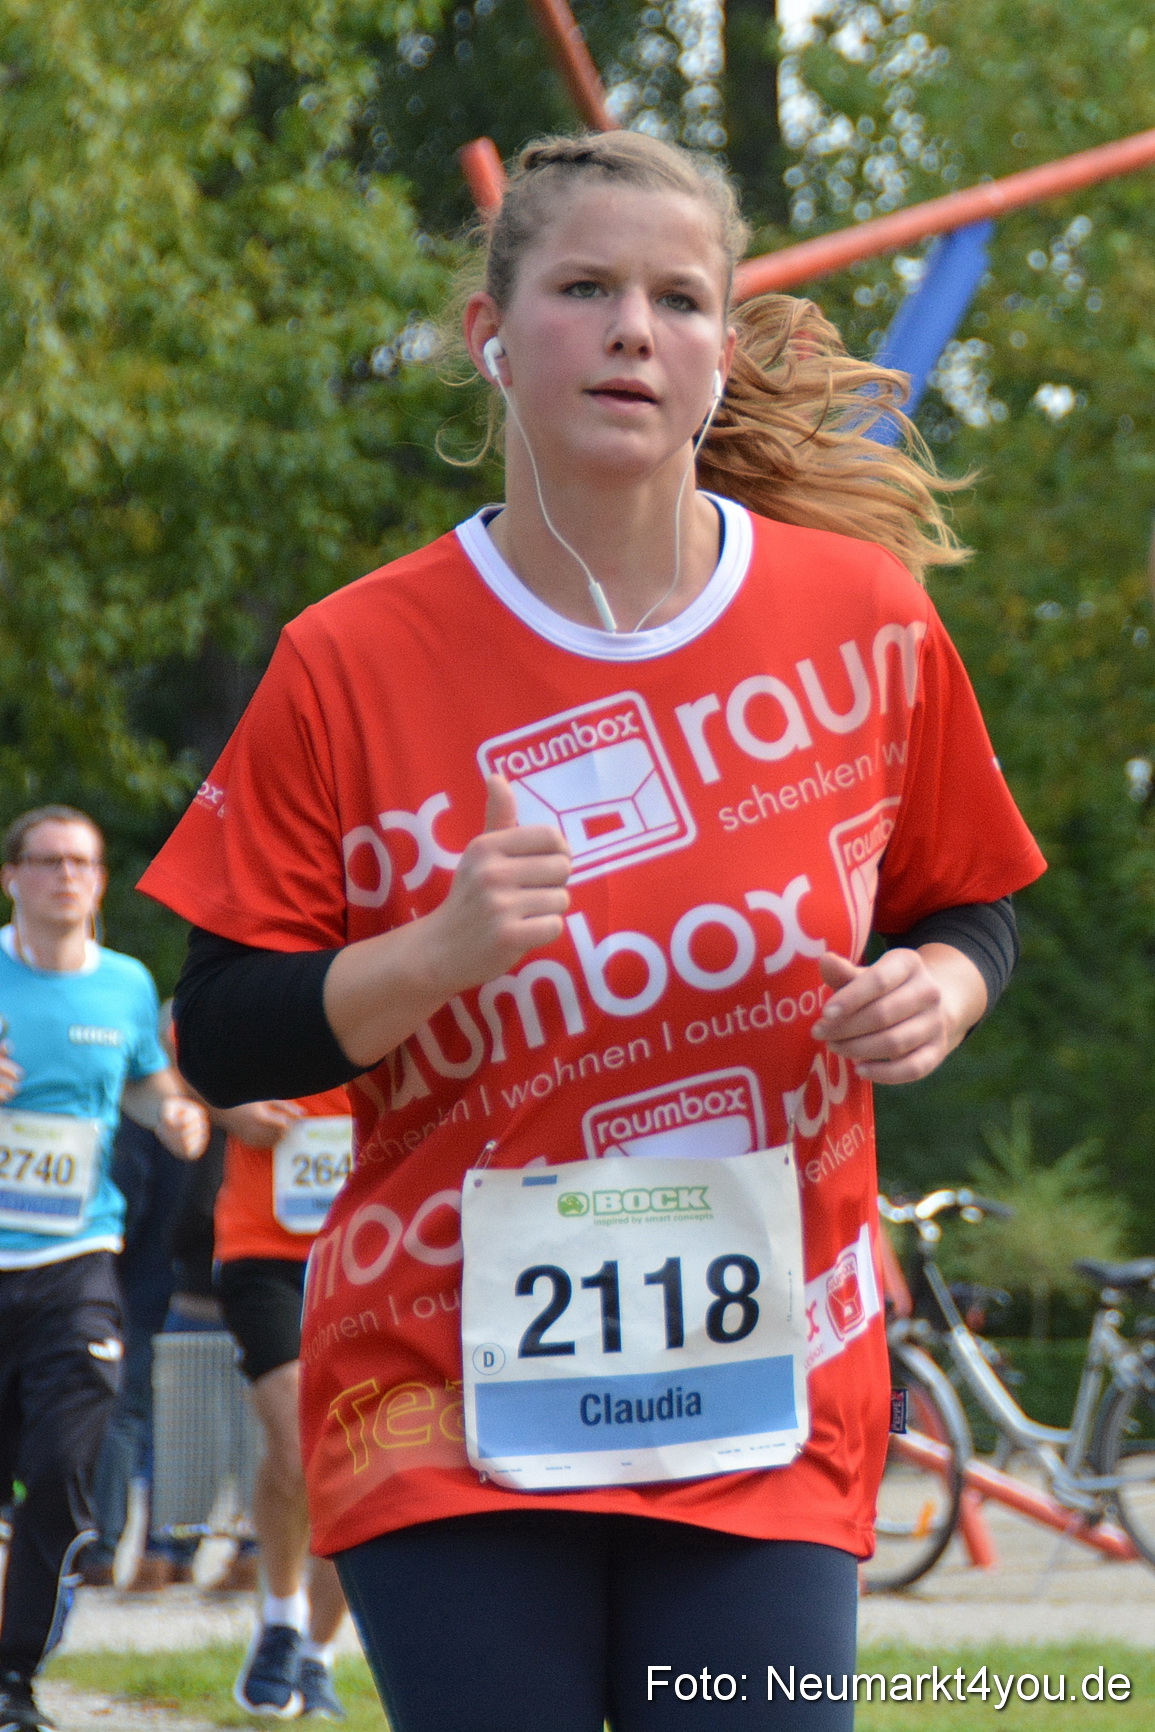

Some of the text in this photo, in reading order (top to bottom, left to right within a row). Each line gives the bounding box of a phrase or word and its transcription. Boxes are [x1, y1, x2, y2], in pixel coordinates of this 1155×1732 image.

[494, 711, 639, 778] raumbox
[719, 755, 873, 831] schenken
[501, 1037, 650, 1110] wohnen
[684, 984, 828, 1044] outdoor
[597, 1086, 747, 1144] raumbox
[0, 1145, 76, 1186] 2740
[592, 1186, 712, 1215] BOCK
[593, 1212, 714, 1226] inspired by smart concepts
[514, 1253, 761, 1360] 2118
[580, 1387, 702, 1427] Claudia
